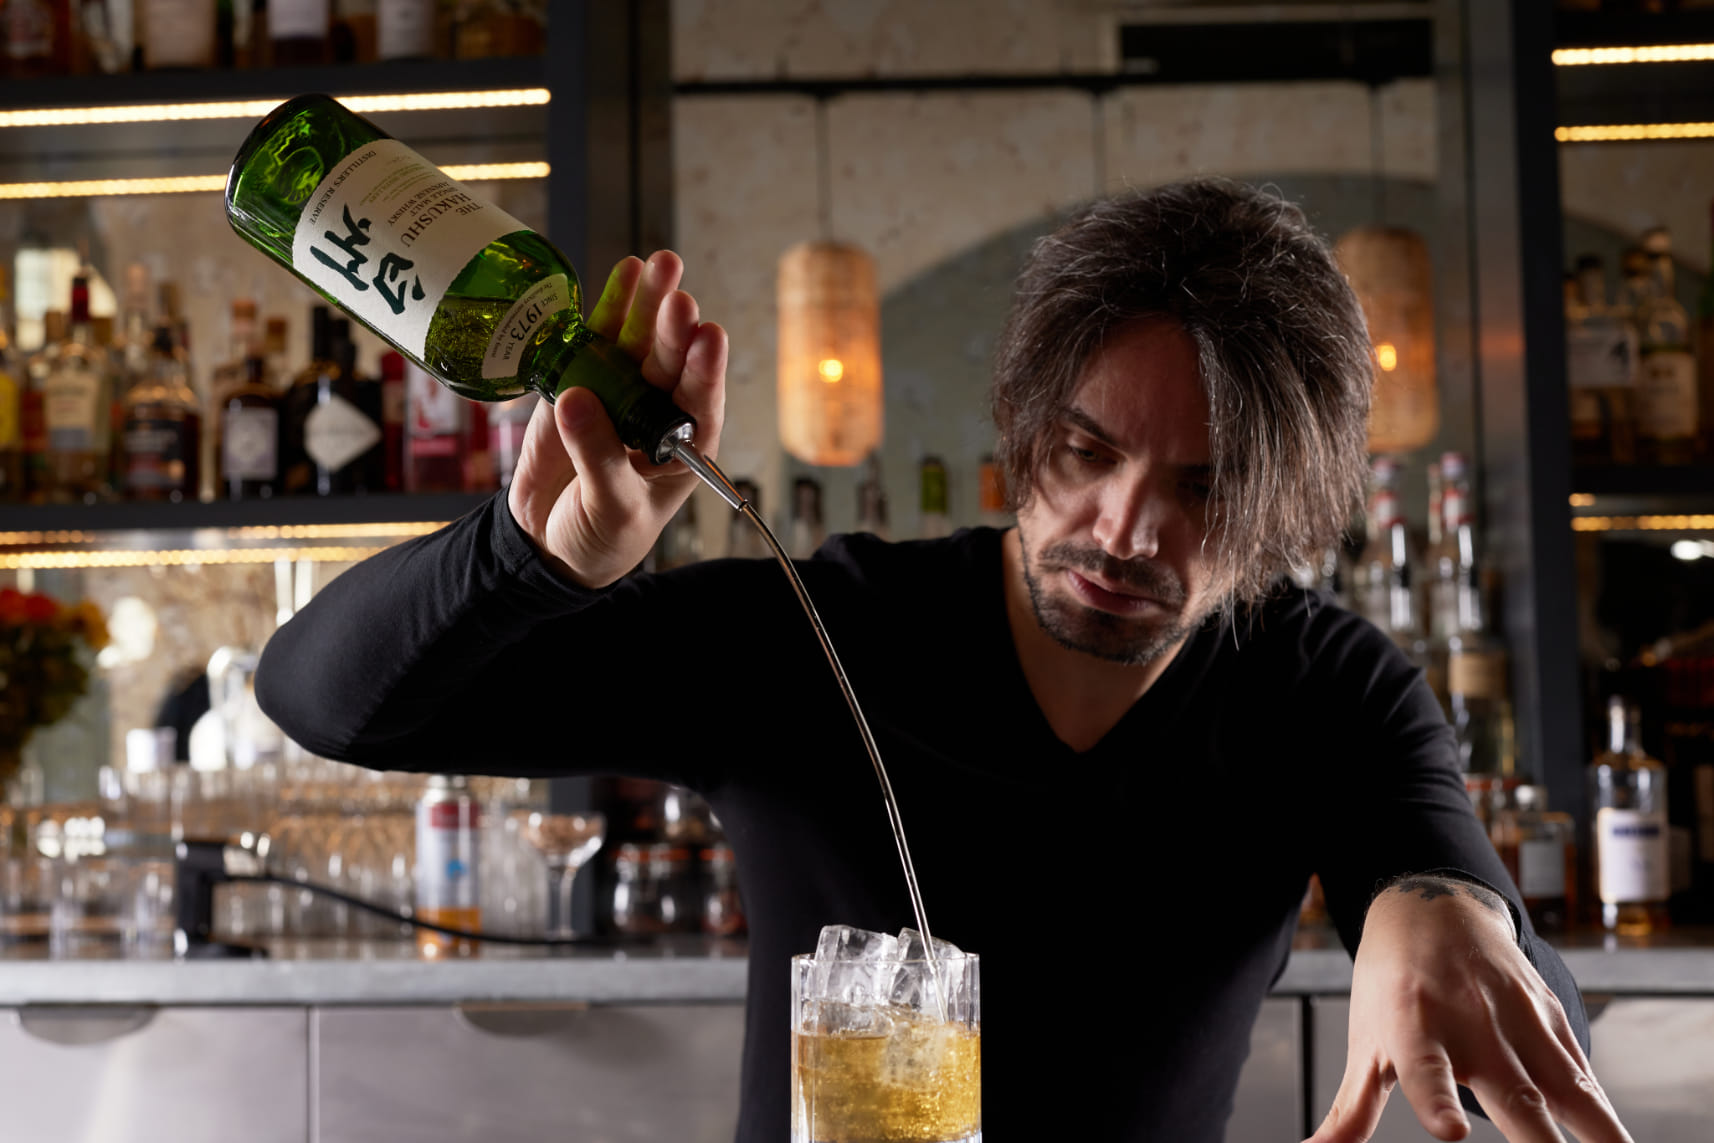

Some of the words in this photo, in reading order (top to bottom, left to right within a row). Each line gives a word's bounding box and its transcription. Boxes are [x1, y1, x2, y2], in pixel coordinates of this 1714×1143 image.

[431, 187, 458, 199] NGLE
[310, 187, 335, 225] RESERVE
[387, 199, 417, 227] WHISKY
[409, 199, 432, 216] MALT
[455, 202, 484, 215] THE
[400, 193, 472, 247] HAKUSHU
[541, 292, 558, 306] SINCE
[511, 303, 543, 341] 1973
[503, 342, 516, 360] YEAR
